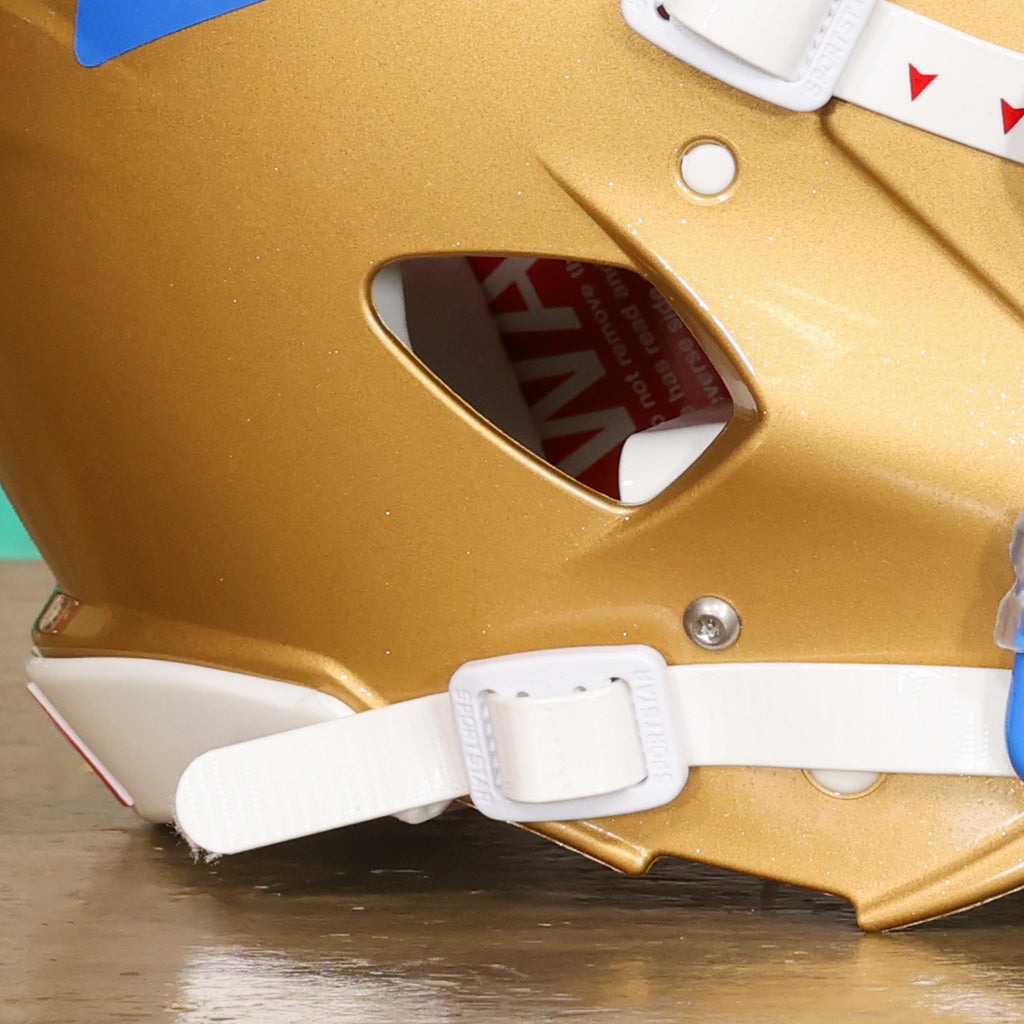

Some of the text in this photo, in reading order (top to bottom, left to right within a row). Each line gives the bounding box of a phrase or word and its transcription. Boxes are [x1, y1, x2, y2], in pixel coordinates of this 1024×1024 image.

[581, 283, 632, 367] remove
[620, 304, 660, 354] read
[624, 370, 656, 409] not
[655, 359, 685, 403] has
